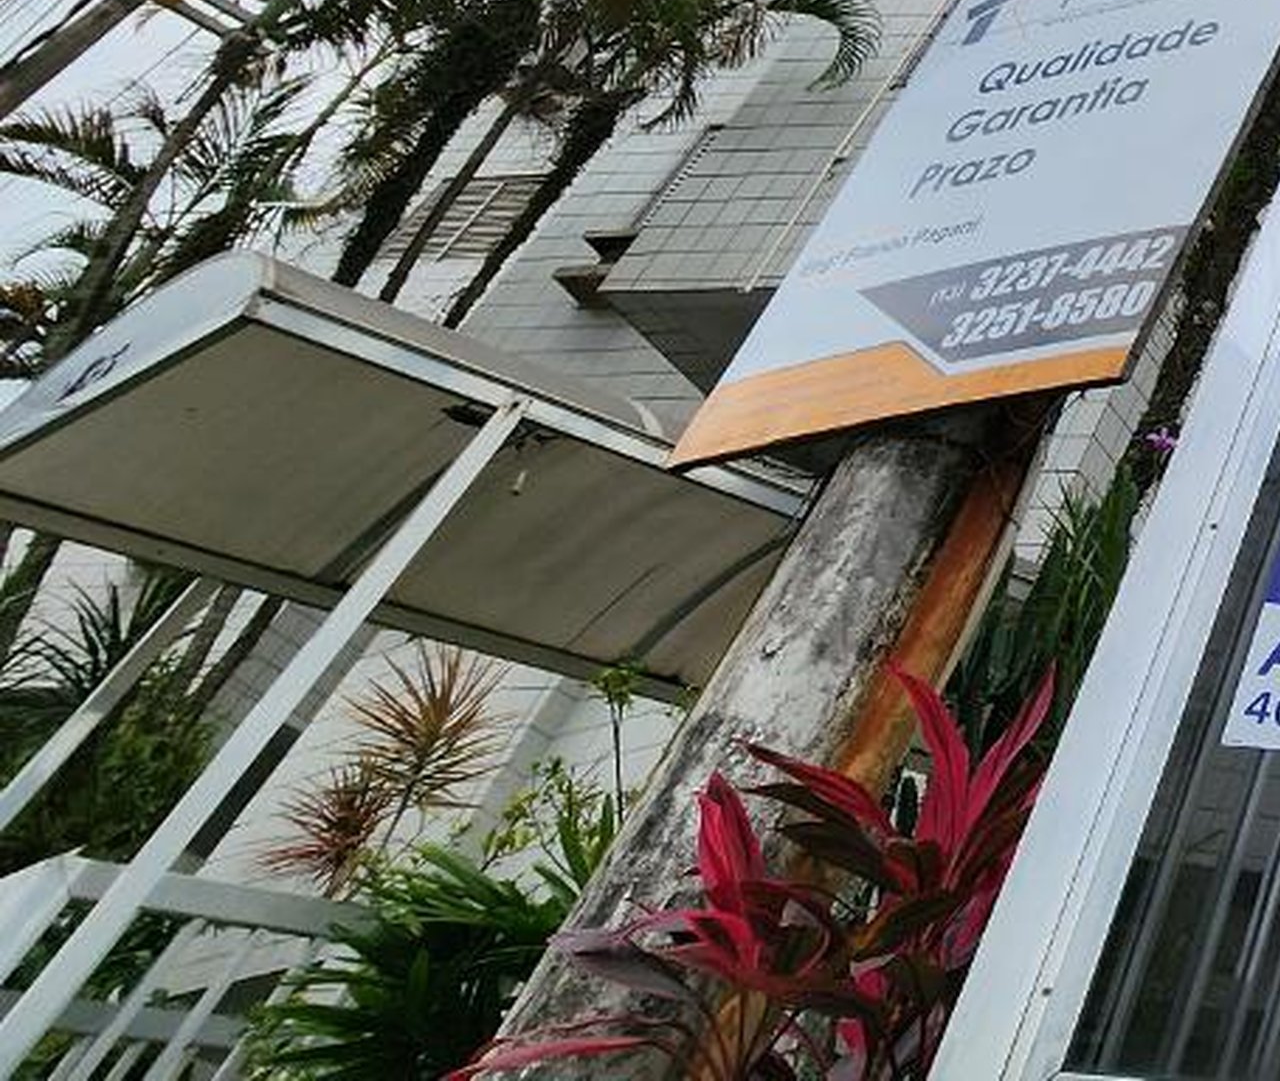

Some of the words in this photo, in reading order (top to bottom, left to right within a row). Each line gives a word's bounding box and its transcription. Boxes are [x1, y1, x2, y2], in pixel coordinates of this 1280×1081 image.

[979, 20, 1219, 93] Qualidade
[947, 77, 1149, 143] Garantia
[909, 149, 1036, 199] Prazo
[970, 235, 1174, 302] 3237-4442
[941, 280, 1156, 348] 3251-8580
